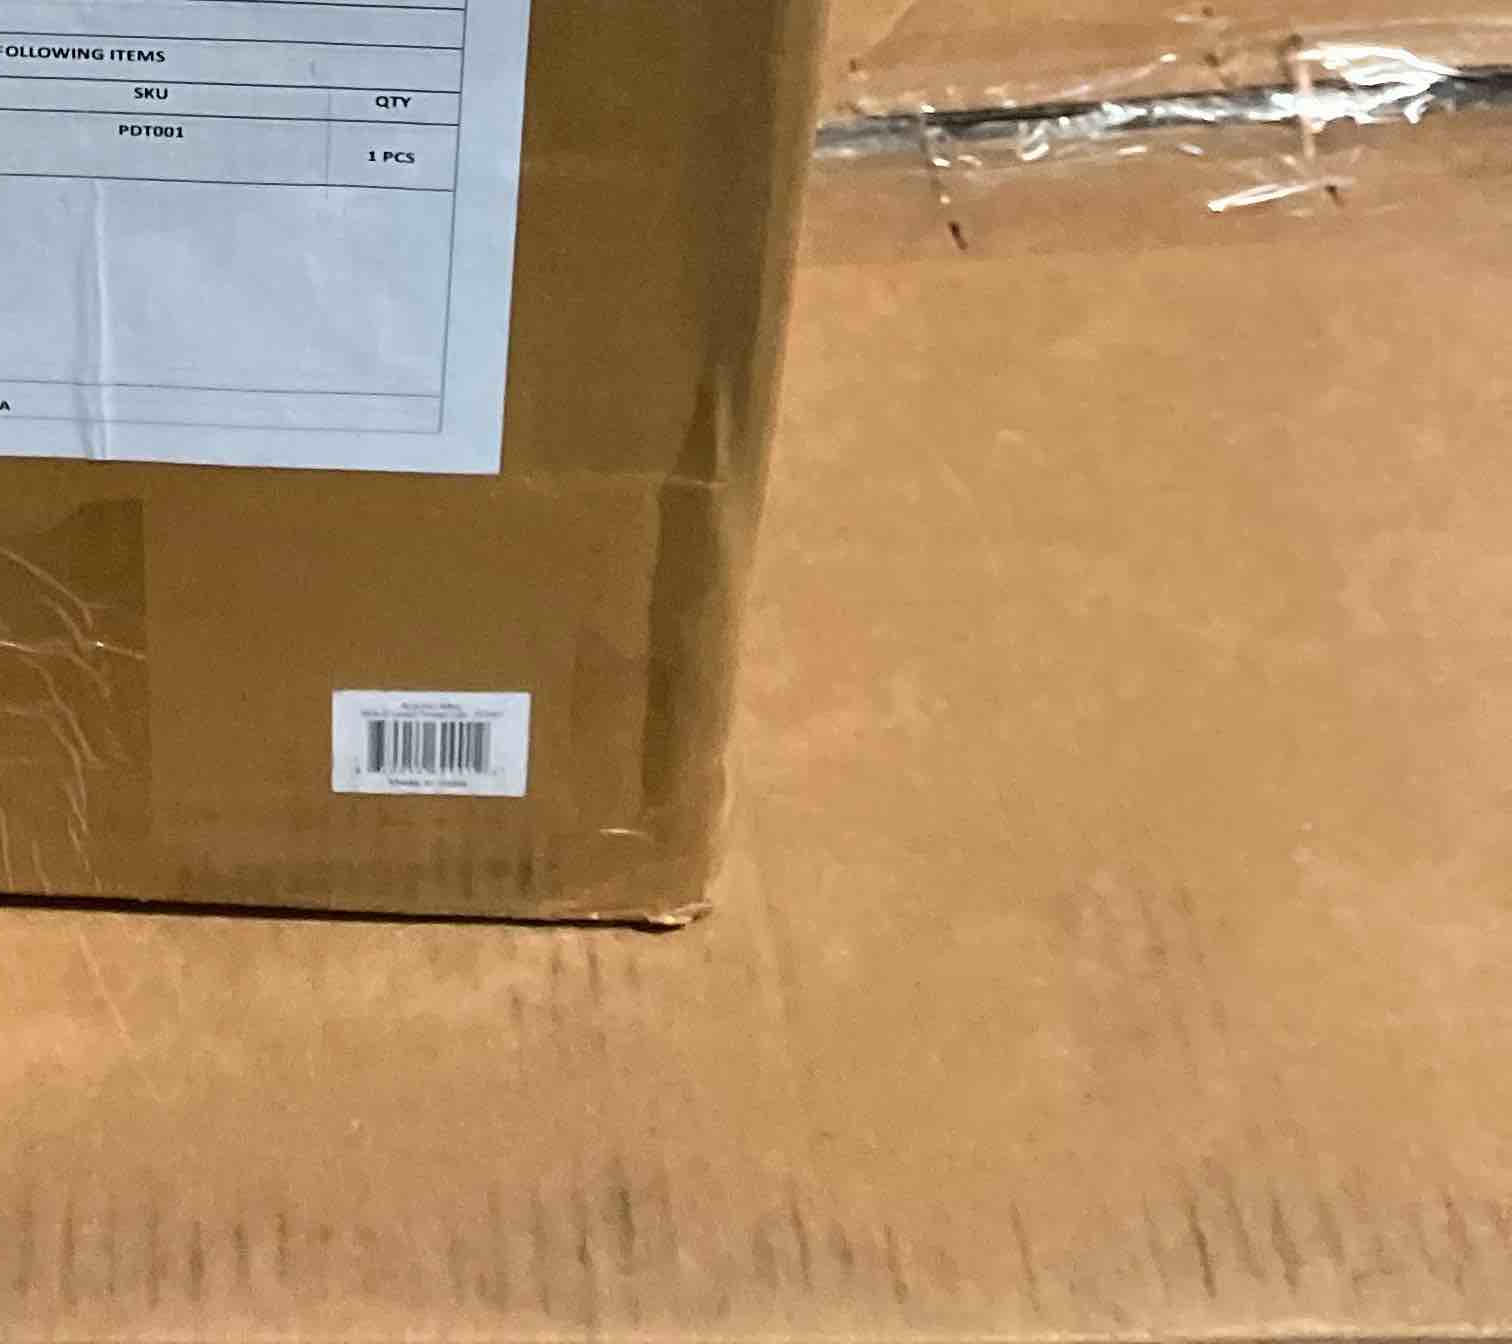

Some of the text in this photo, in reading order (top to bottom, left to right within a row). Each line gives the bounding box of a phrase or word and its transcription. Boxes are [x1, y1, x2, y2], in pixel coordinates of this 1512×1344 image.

[109, 48, 166, 63] ITEMS
[133, 87, 169, 100] SKU
[375, 96, 411, 109] QTY
[118, 124, 185, 139] PDT001
[367, 150, 416, 164] 1 PCS
